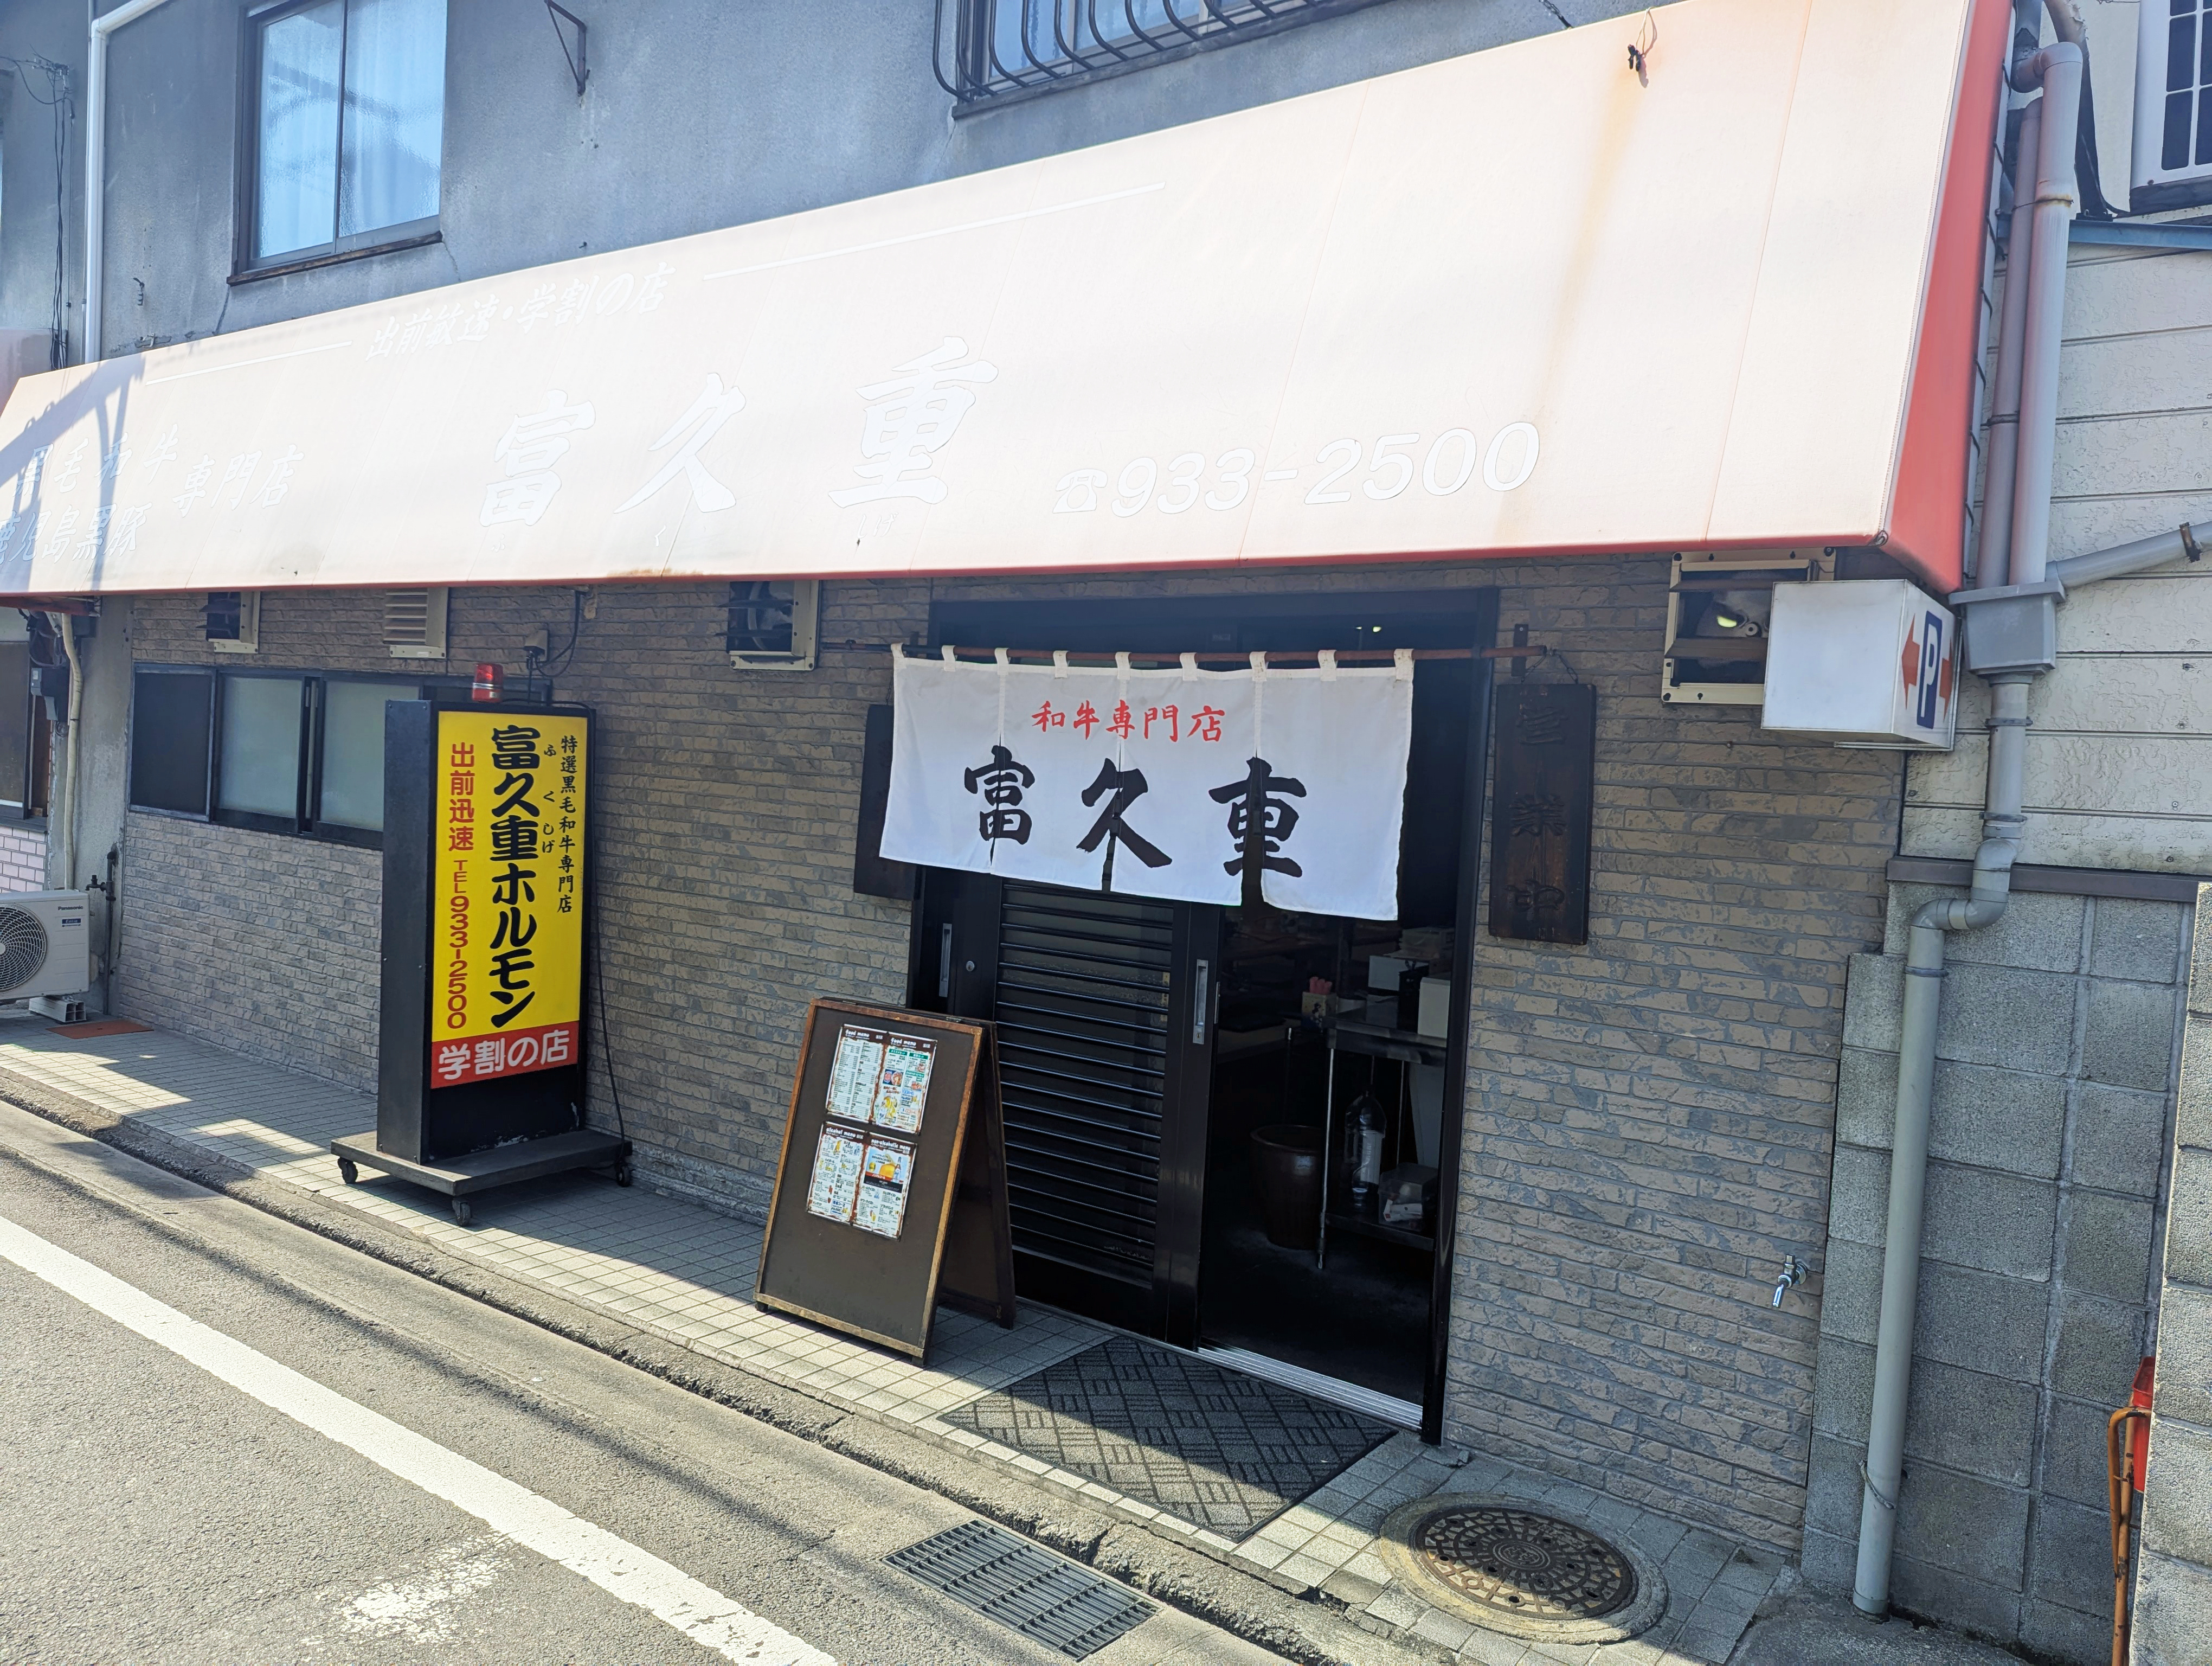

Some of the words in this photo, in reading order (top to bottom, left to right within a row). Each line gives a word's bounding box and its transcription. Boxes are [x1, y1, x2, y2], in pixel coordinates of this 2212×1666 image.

[12, 423, 179, 497] 黒毛和牛
[478, 337, 999, 527] 富久重
[1111, 422, 1540, 518] 933-2500
[172, 444, 305, 518] 専門店
[1921, 623, 1938, 717] P
[1032, 700, 1226, 742] 和牛専門店
[449, 742, 475, 853] 出前迅速
[557, 735, 578, 913] 特選黒毛和牛専門店
[964, 745, 1307, 878] 富久重
[490, 725, 542, 1029] 富久重ホルモン
[438, 1029, 570, 1081] 学割の店
